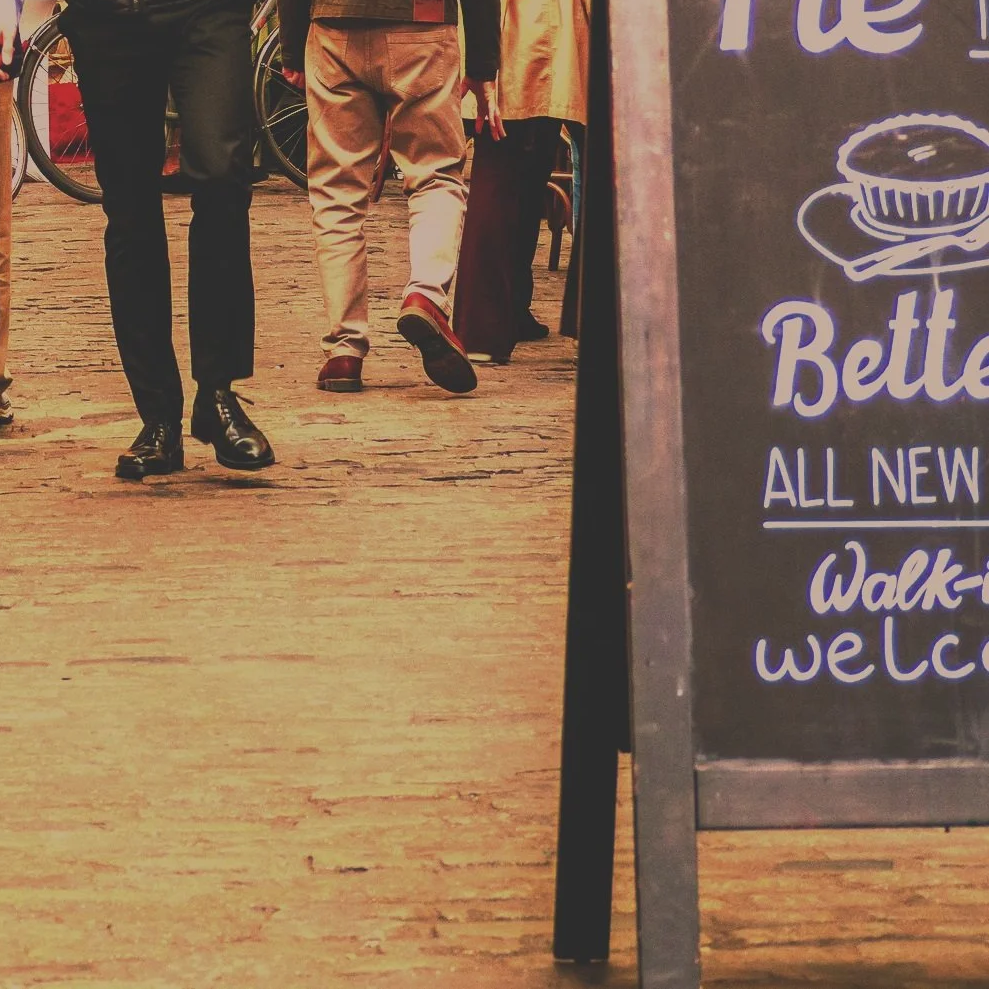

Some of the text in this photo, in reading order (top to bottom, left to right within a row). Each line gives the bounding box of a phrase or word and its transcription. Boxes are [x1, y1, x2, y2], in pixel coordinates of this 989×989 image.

[763, 446, 980, 509] ALL NEW
[755, 616, 989, 683] welc
